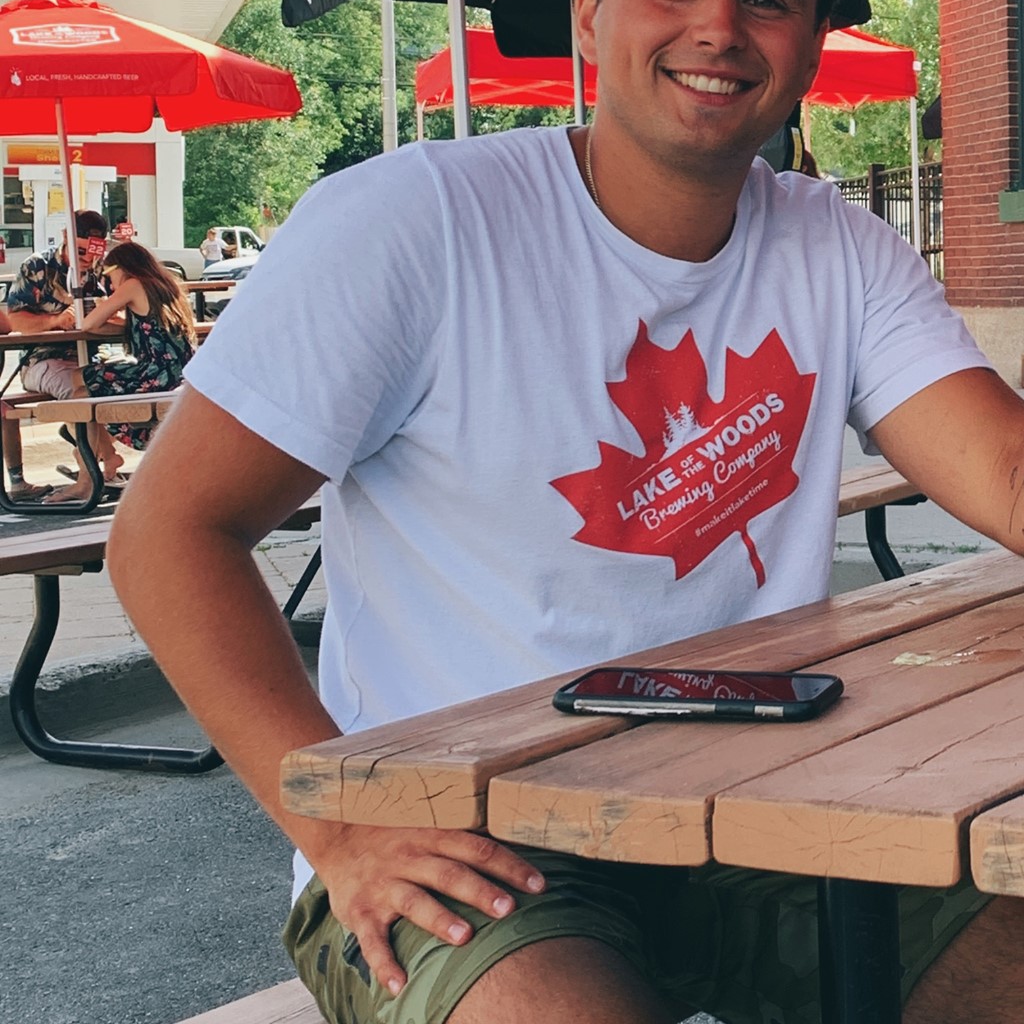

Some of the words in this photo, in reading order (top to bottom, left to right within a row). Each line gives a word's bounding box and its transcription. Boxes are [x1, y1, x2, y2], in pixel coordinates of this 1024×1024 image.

[72, 149, 82, 162] 2
[88, 244, 104, 255] 22
[696, 393, 785, 462] WOODS
[680, 454, 696, 468] OF
[682, 461, 706, 479] THE
[617, 467, 683, 521] LAKE
[639, 481, 715, 531] Brewing
[713, 430, 782, 484] Company
[695, 479, 769, 538] #makeitlaketime
